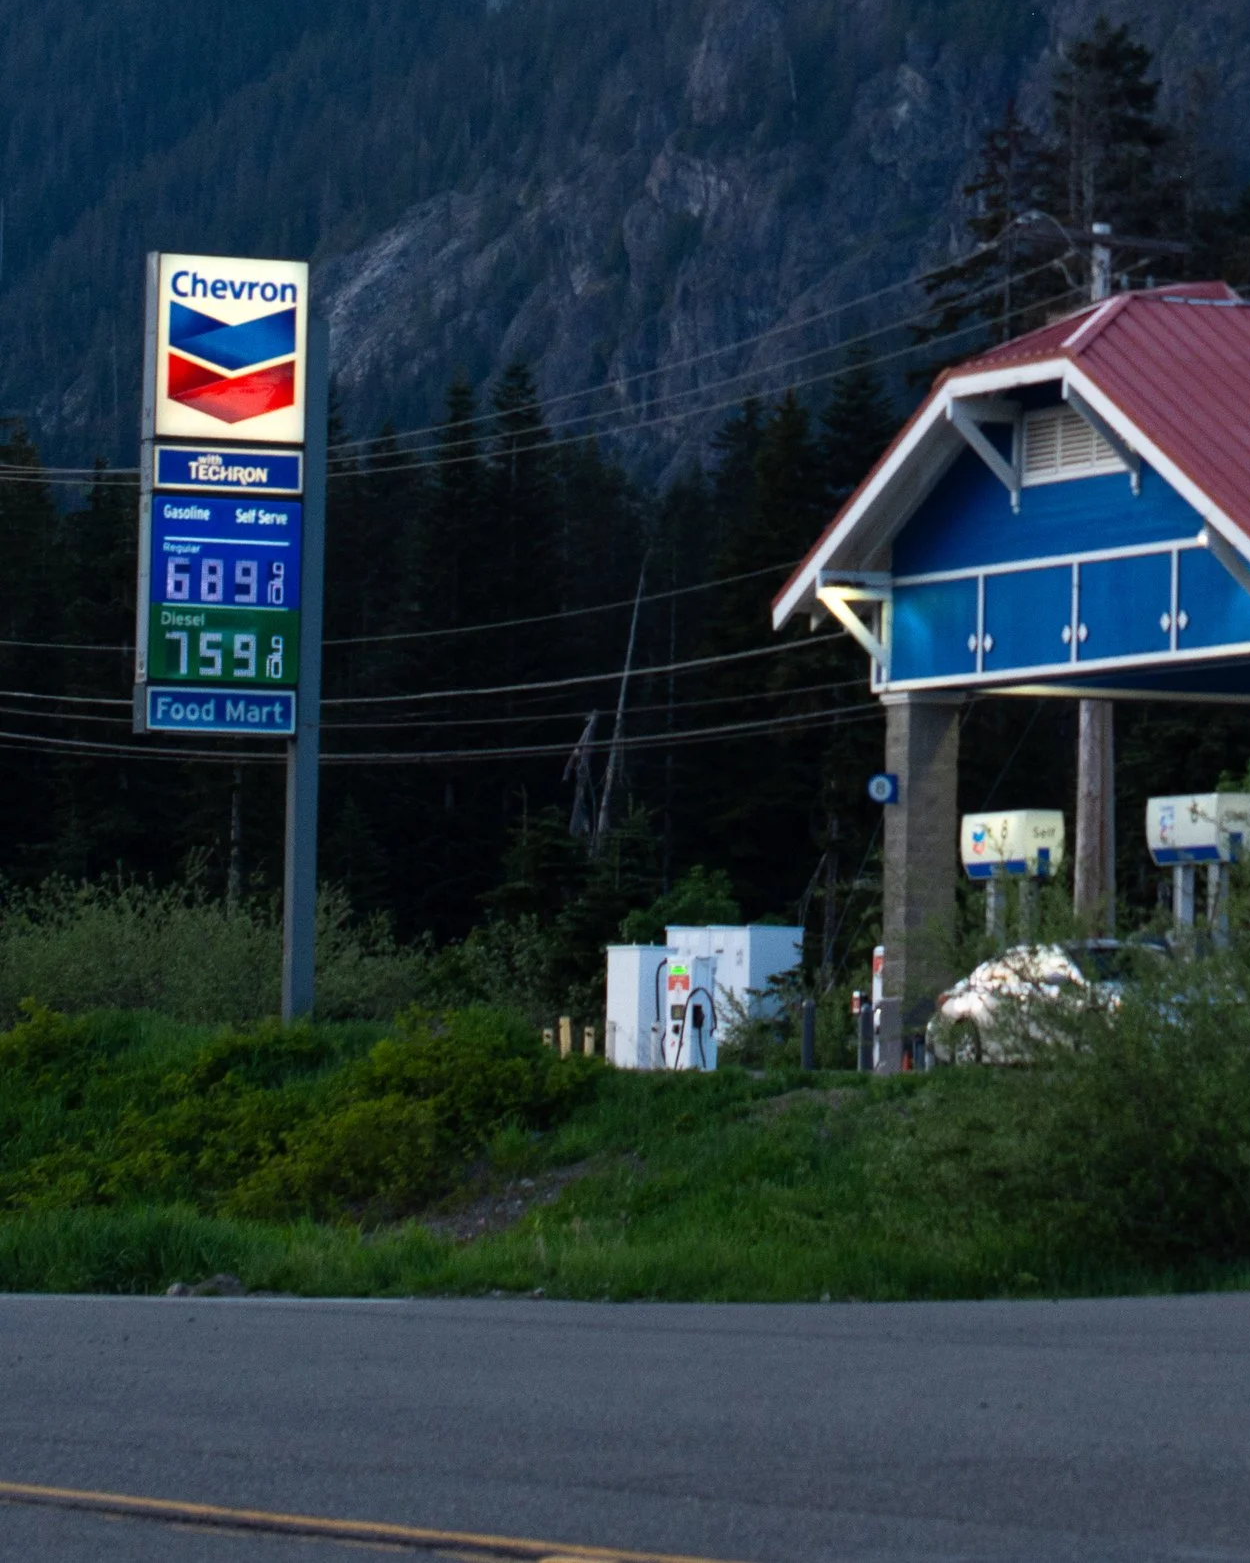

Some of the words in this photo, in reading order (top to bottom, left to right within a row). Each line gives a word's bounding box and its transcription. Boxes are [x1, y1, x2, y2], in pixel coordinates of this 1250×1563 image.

[171, 270, 297, 303] Chevron
[197, 454, 223, 466] with
[188, 461, 269, 486] TECHRON
[163, 504, 210, 521] Gasoline
[235, 508, 256, 524] Self
[258, 510, 288, 526] Serve
[162, 542, 200, 555] Regular
[166, 557, 258, 603] 689
[160, 611, 205, 627] Diesel
[165, 631, 257, 677] 759
[156, 696, 215, 722] Food
[225, 699, 284, 724] Mart
